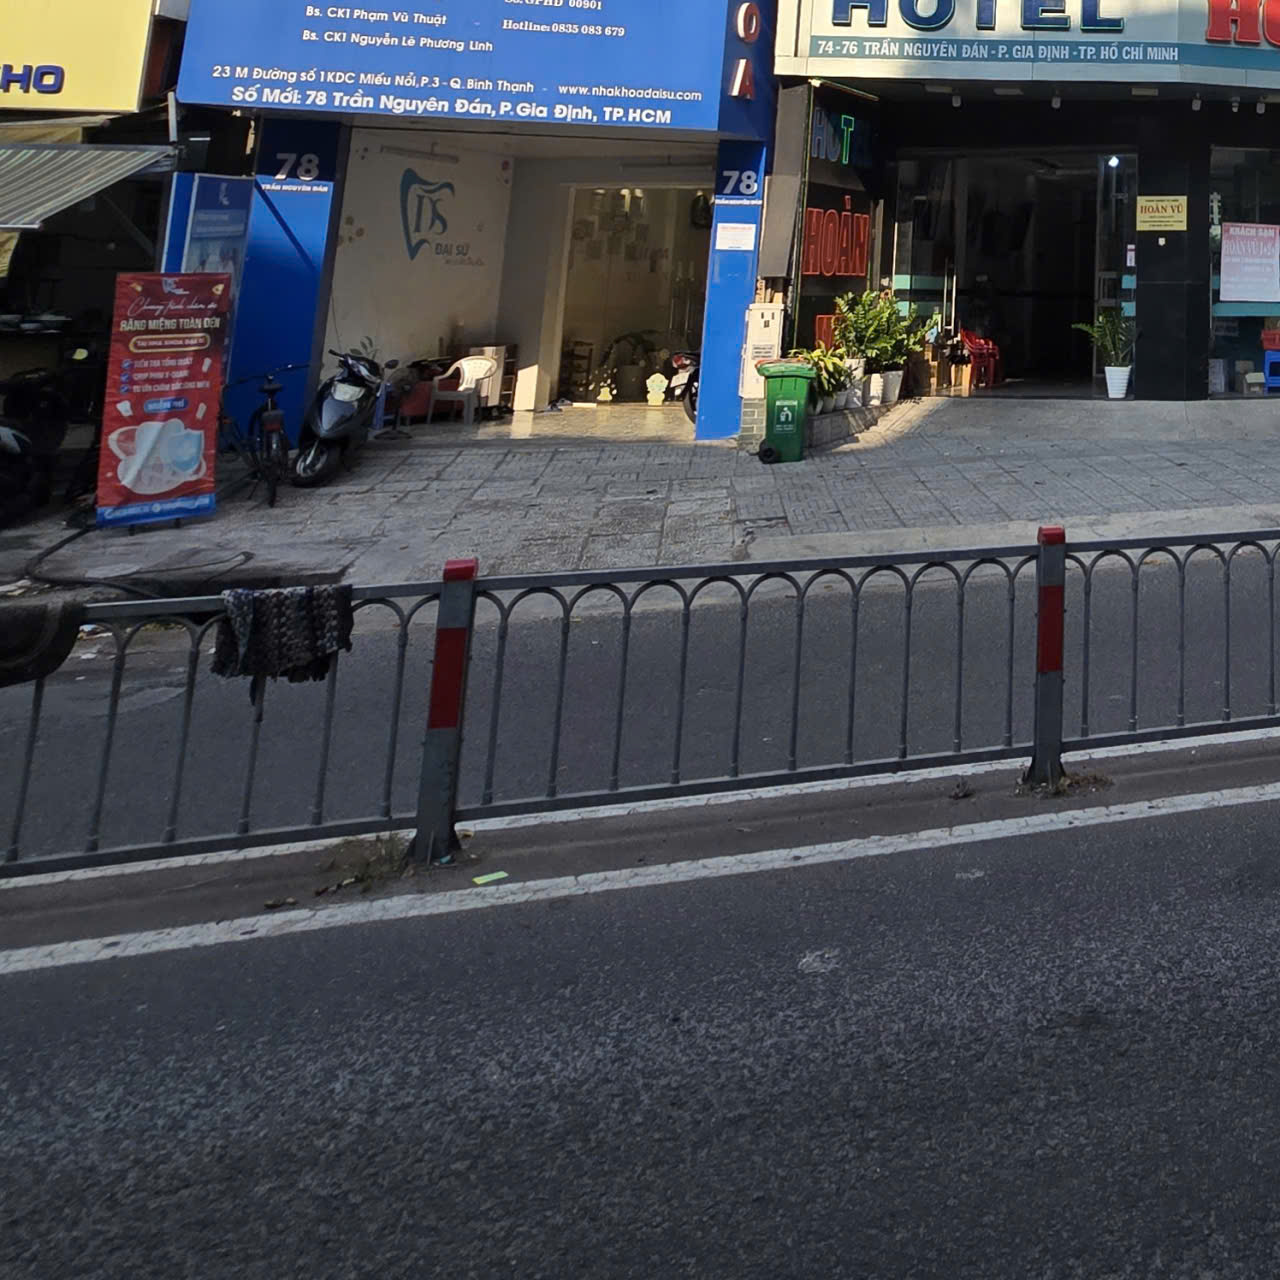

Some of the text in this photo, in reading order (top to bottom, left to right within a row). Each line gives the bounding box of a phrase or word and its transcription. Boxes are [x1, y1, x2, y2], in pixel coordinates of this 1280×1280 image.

[305, 6, 323, 18] Bs.
[327, 7, 351, 19] CK1
[353, 9, 388, 24] Phạm
[413, 13, 447, 27] Thuật
[302, 29, 320, 41] Bs.
[324, 31, 347, 43] CK1
[350, 32, 399, 48] Nguyễn
[419, 36, 465, 52] Phương
[469, 40, 494, 52] Linh
[551, 22, 579, 35] 0835
[581, 23, 603, 36] 083
[604, 25, 626, 38] 679
[817, 40, 858, 55] 74-76
[863, 37, 899, 57] TRẦN
[903, 40, 957, 58] NGUYÊN
[961, 41, 989, 59] ĐÁN
[1012, 46, 1034, 60] GIA
[1038, 44, 1070, 62] ĐỊNH
[1100, 41, 1119, 61] HỒ
[1122, 42, 1144, 61] CHÍ
[1147, 46, 1179, 61] MINH
[0, 64, 65, 94] HO
[212, 65, 231, 78] 23
[235, 66, 249, 79] M
[252, 67, 297, 83] Đường
[300, 68, 317, 82] số
[359, 71, 392, 86] Miếu
[496, 80, 535, 94] Thạnh
[558, 84, 703, 102] www.nhakhoadaisu.com
[232, 84, 258, 102] Số
[262, 86, 301, 104] Mới:
[305, 90, 328, 106] 78
[333, 88, 374, 108] Trần
[379, 94, 449, 115] Nguyên
[455, 96, 496, 117] Đán,
[553, 103, 598, 122] Định,
[603, 106, 672, 124] TP.HCM
[274, 153, 320, 180] 78
[722, 170, 758, 195] 78
[1140, 203, 1168, 214] HOÀN
[801, 195, 870, 277] HOÀN
